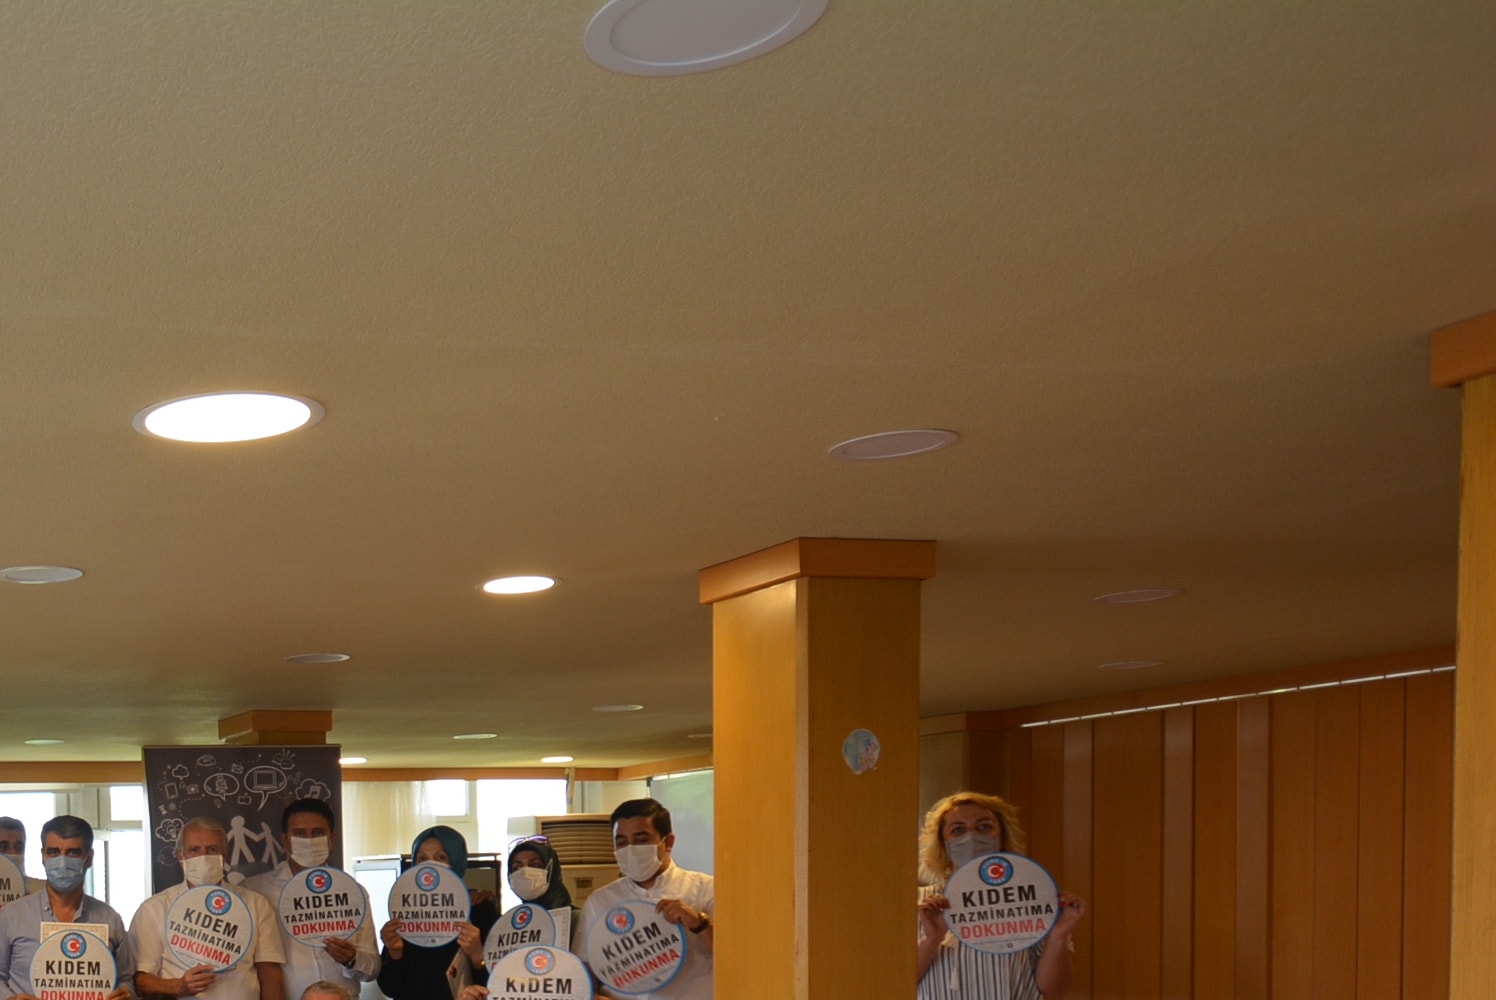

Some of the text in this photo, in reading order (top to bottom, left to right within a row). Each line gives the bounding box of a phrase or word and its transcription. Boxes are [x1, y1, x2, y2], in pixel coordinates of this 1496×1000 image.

[294, 893, 349, 910] KIDEM
[402, 893, 454, 908] KIDEM
[962, 884, 1036, 908] KIDEM
[184, 908, 239, 938] KIDEM
[284, 908, 361, 924] TAZMİNATIMA
[392, 909, 466, 920] TAZMİNATIMA
[950, 904, 1054, 924] TAZMİNATIMA
[168, 920, 242, 954] TAZMİNATIMA
[292, 920, 356, 936] DOKUNMA
[960, 918, 1047, 940] DOKUNMA
[498, 929, 542, 948] KIDEM
[602, 922, 662, 960] KIDEM
[170, 934, 231, 965] DOKUNMA
[600, 933, 680, 978] TAZMİNATIMA
[46, 960, 100, 976] KIDEM
[612, 948, 681, 988] DOKUNMA
[34, 977, 111, 990] TAZMİNATIMA
[506, 977, 572, 994] KIDEM
